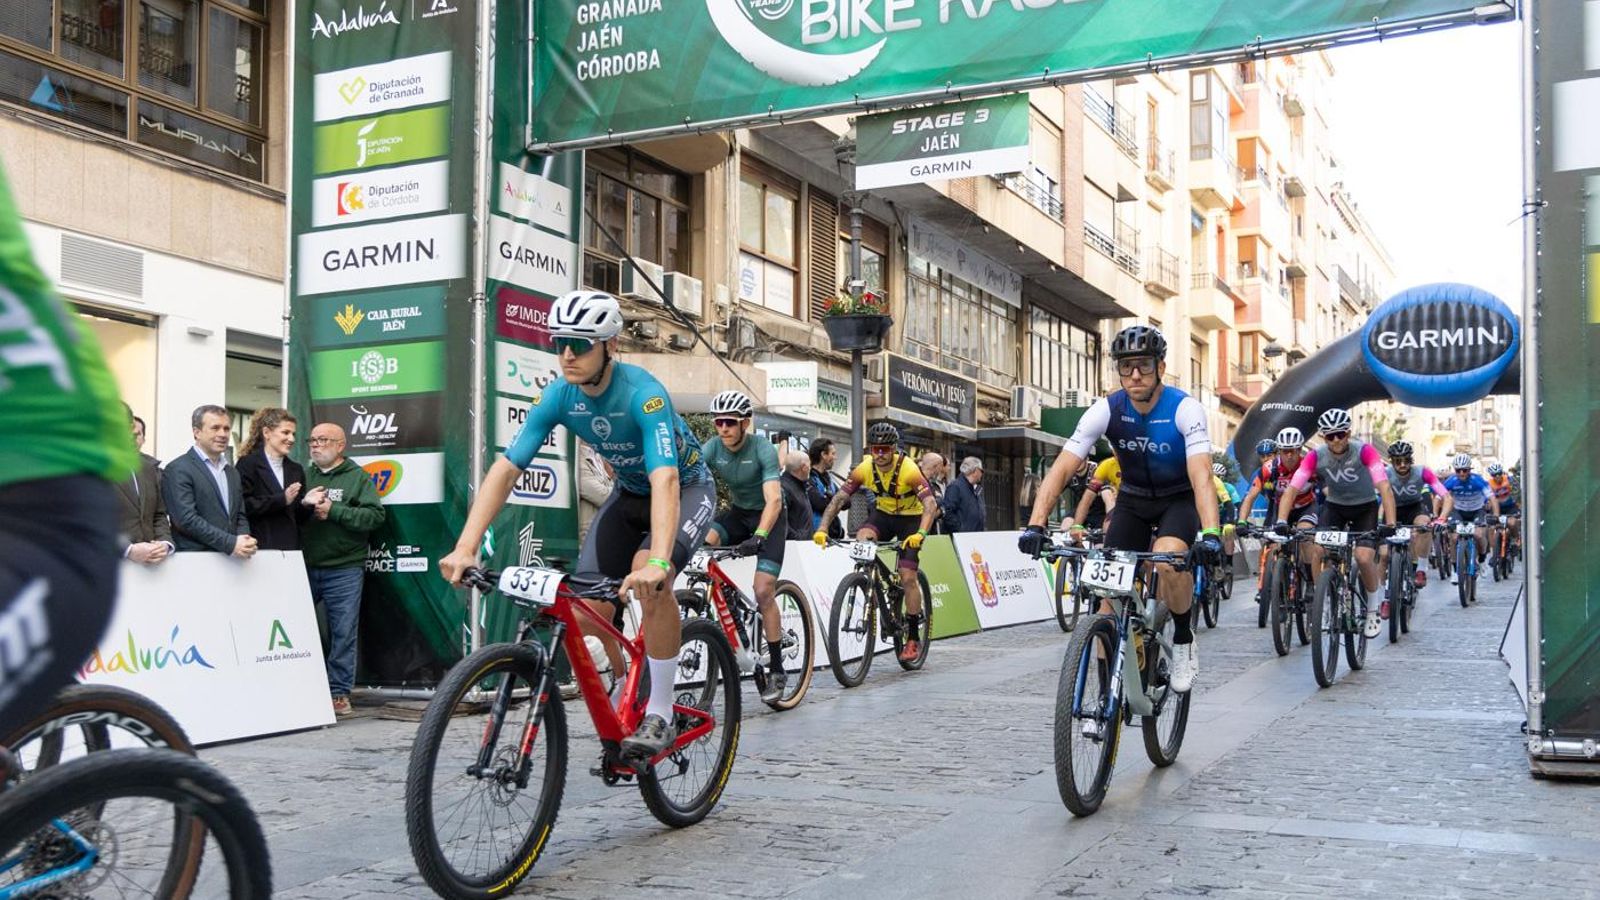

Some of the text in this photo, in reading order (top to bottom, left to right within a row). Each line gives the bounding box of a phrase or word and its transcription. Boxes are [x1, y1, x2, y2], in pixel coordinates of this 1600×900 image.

[312, 1, 400, 39] Andalucía
[577, 0, 662, 25] GRANADA
[577, 23, 623, 52] JAÉN
[577, 49, 661, 81] CÓRDOBA
[369, 75, 422, 92] Diputación
[369, 86, 424, 104] de Granada
[892, 109, 990, 134] STAGE 3
[140, 116, 257, 165] MURIANA
[920, 131, 960, 152] JAÉN
[910, 160, 972, 177] GARMIN
[368, 181, 419, 196] Diputación
[368, 199, 380, 208] de
[323, 238, 434, 272] GARMIN
[500, 241, 567, 277] GARMIN
[367, 306, 422, 321] CAJA RURAL
[382, 320, 405, 332] JAÉN
[1377, 325, 1498, 350] GARMIN
[901, 370, 966, 404] VERÓNICA Y JESÚS
[1261, 401, 1314, 413] garmin.com
[351, 413, 398, 435] NDL
[1321, 532, 1341, 542] 62-1
[365, 560, 395, 572] RACE
[995, 568, 1038, 580] AYUNTAMIENTO
[1091, 562, 1124, 584] 35-1
[510, 568, 551, 596] 53-1
[999, 584, 1024, 597] DE JAÉN
[256, 650, 312, 663] Junta de Andalucía
